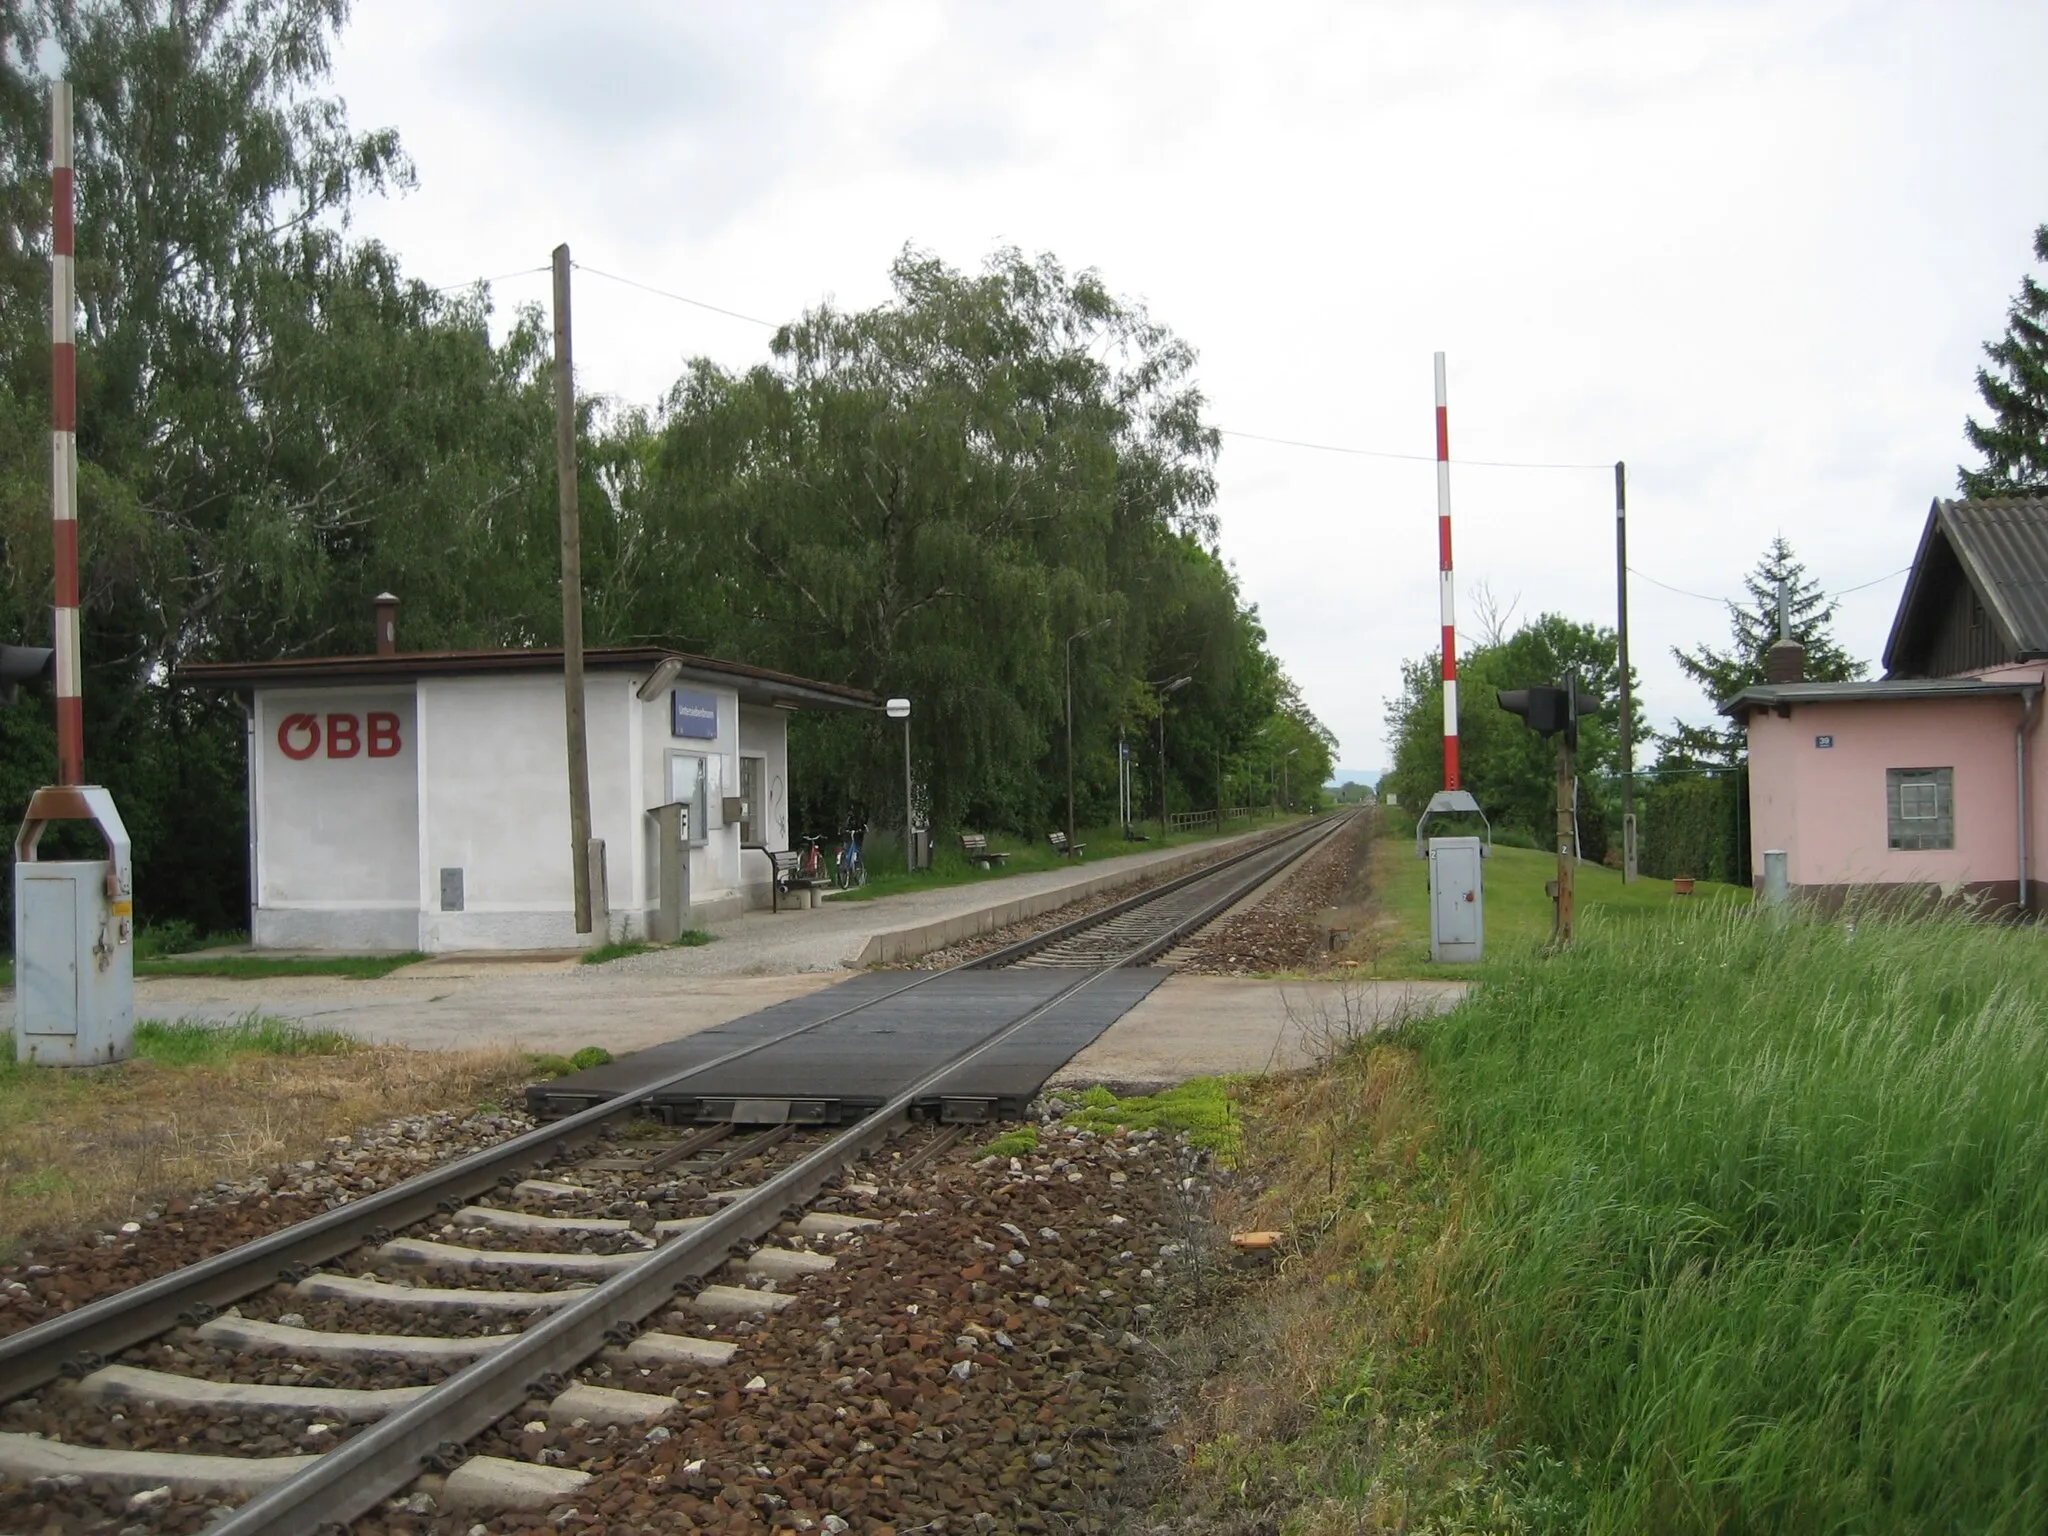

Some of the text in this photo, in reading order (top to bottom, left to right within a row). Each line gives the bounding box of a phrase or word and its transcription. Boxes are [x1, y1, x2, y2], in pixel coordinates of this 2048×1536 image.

[278, 711, 402, 760] ÖBB
[681, 813, 687, 835] F
[1431, 850, 1437, 859] 2
